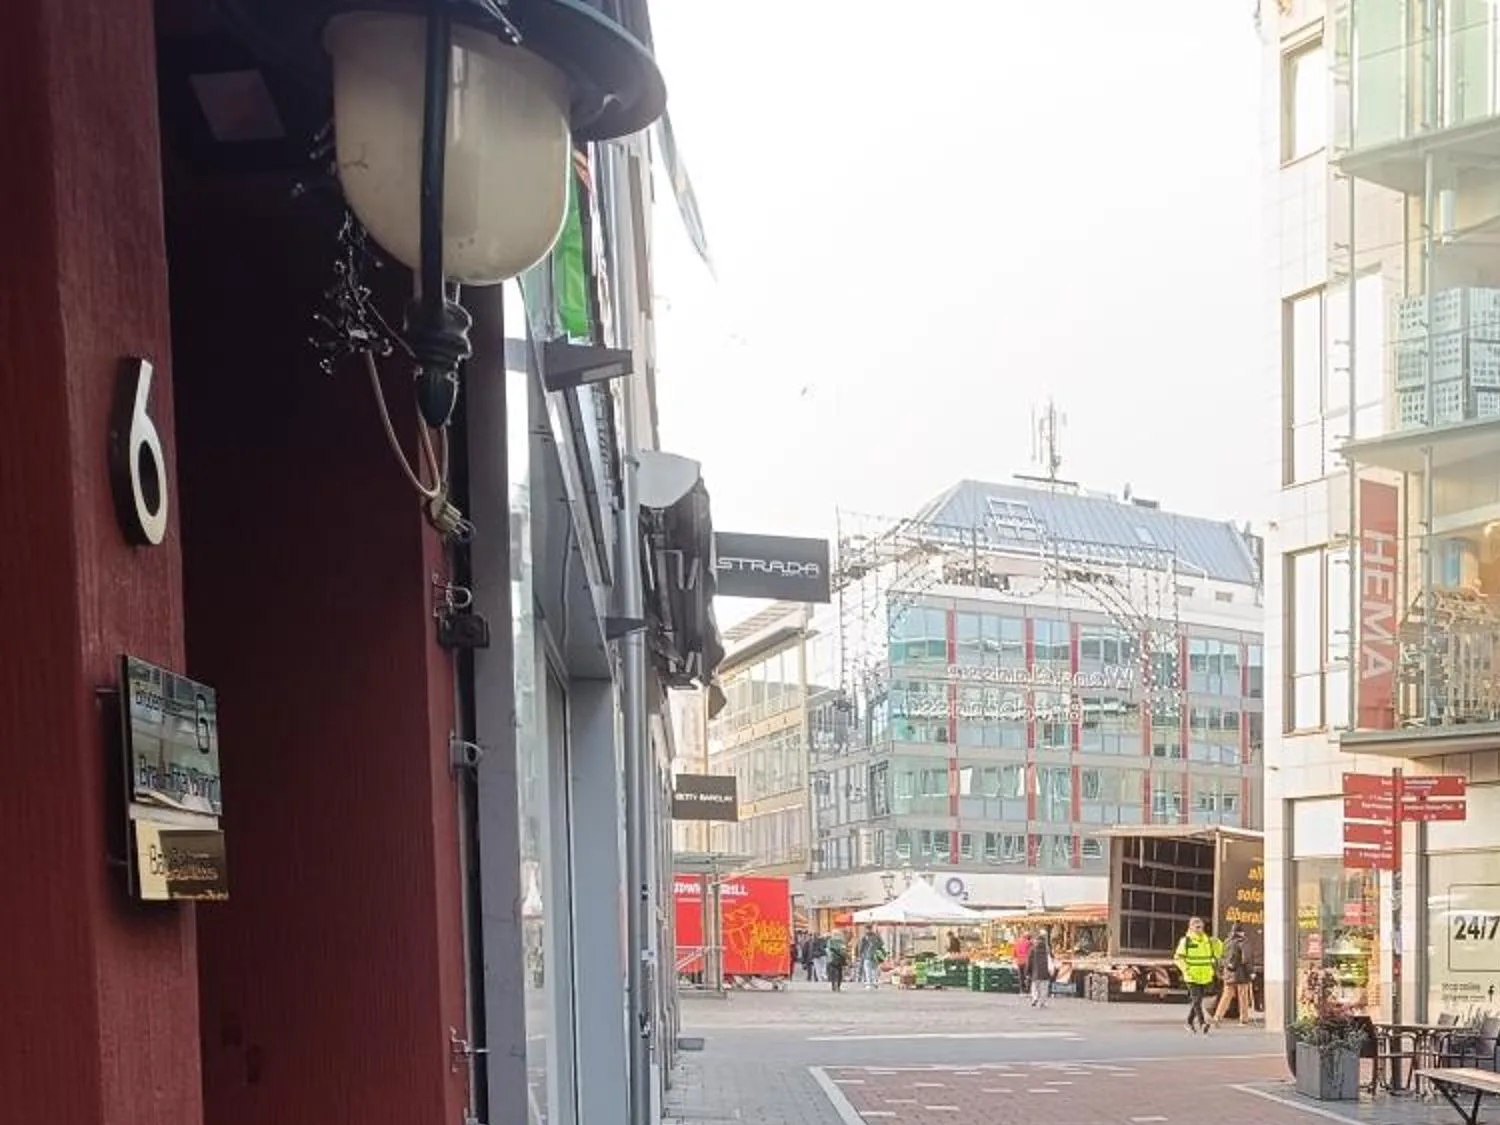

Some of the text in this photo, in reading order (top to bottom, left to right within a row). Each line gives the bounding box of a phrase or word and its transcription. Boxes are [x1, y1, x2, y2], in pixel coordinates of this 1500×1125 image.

[129, 359, 168, 545] 6
[716, 556, 820, 578] STRADA
[1362, 528, 1394, 680] HEMA
